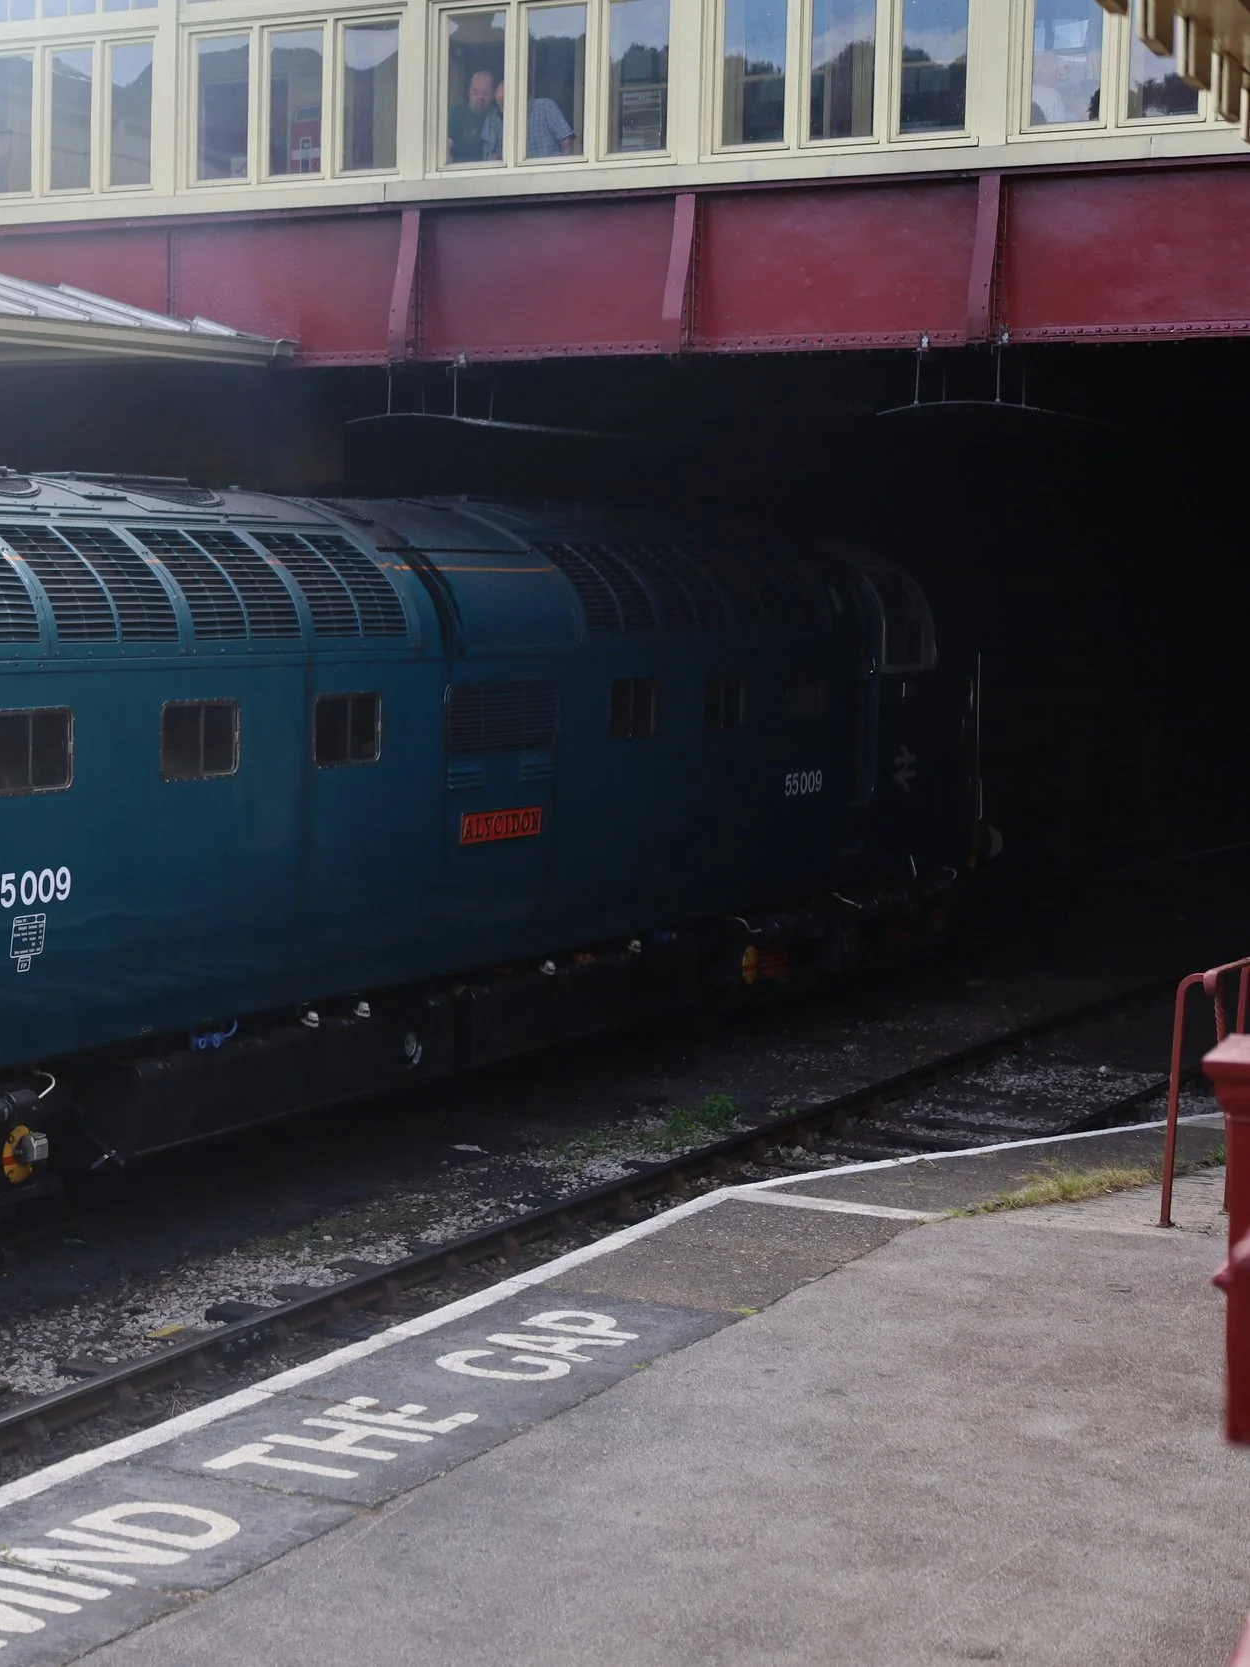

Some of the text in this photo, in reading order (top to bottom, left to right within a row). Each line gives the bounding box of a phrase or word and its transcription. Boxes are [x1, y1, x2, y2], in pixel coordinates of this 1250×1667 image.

[462, 810, 540, 840] ALYCIDON
[201, 1396, 479, 1480] THE
[435, 1310, 640, 1381] GAP
